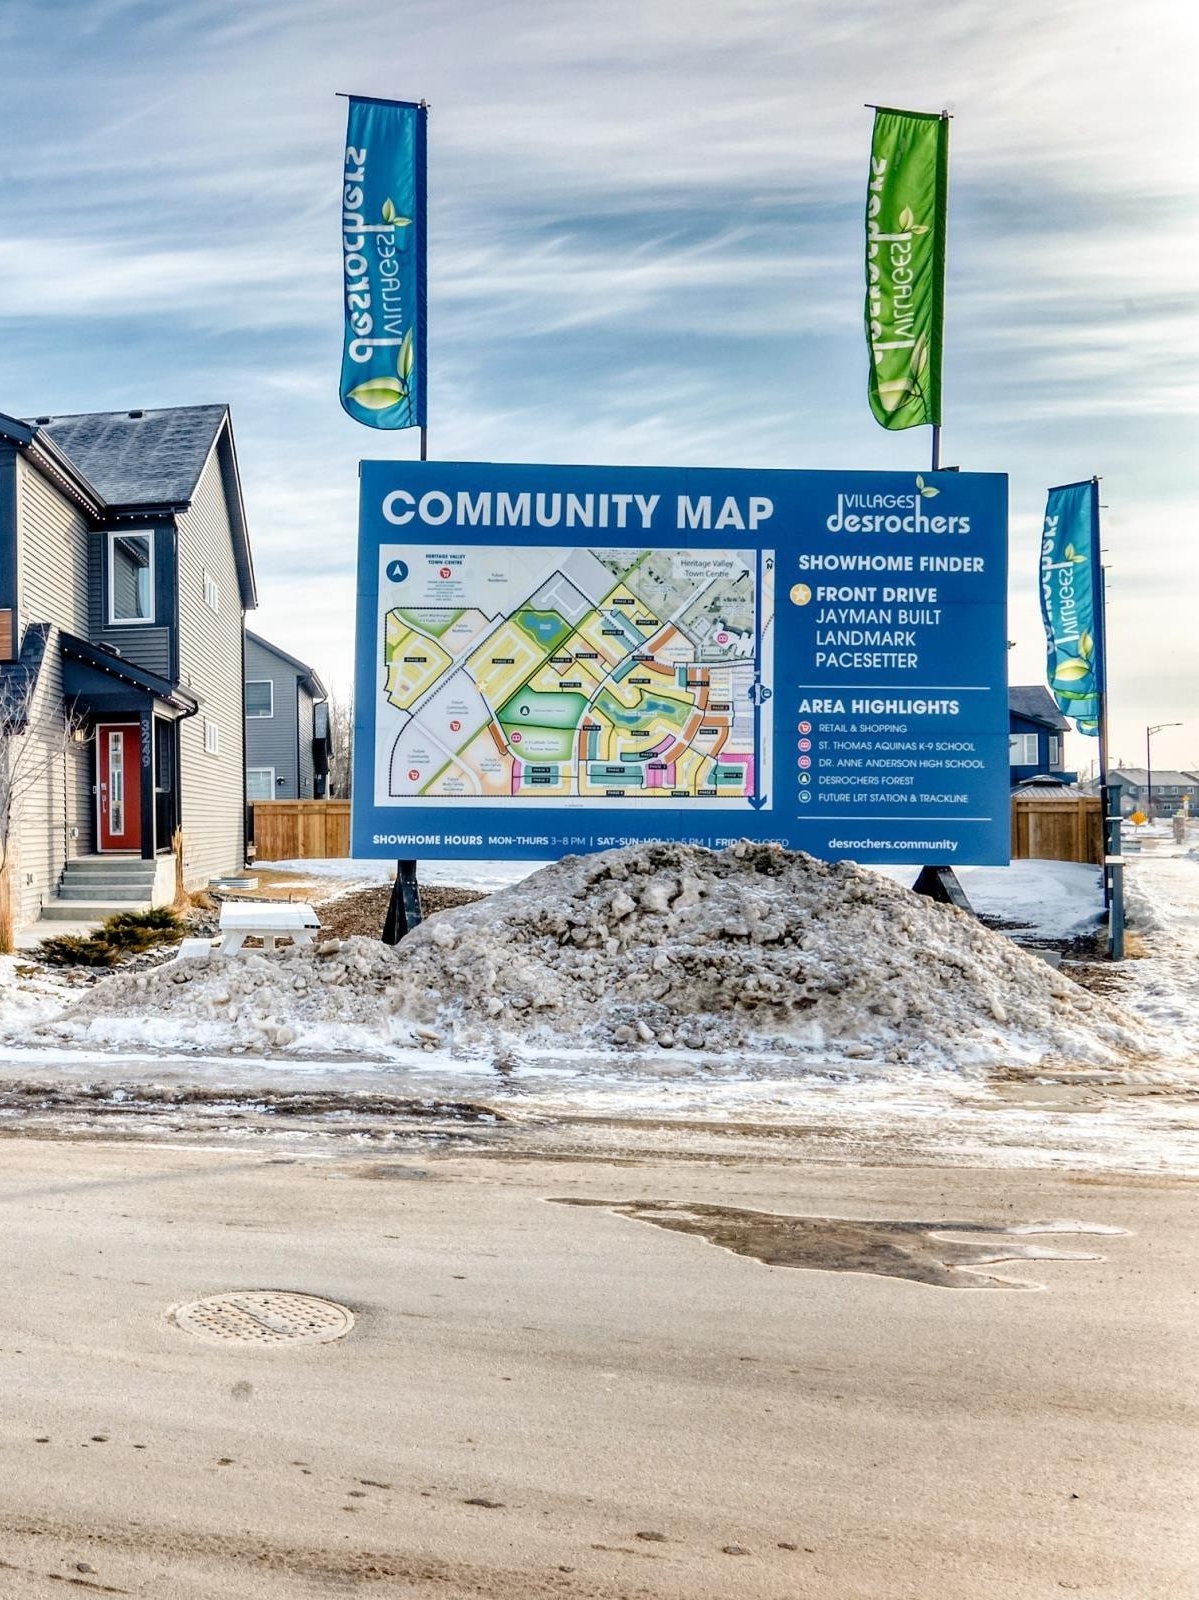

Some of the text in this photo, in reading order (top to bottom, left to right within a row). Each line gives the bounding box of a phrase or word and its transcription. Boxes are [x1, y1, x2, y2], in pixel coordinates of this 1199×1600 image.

[844, 494, 915, 509] VILLAGES
[382, 489, 774, 530] COMMUNITY MAP
[826, 493, 971, 534] desrochers
[681, 559, 734, 569] Heritage Valley
[798, 554, 984, 573] SHOWHOME FINDER
[816, 586, 937, 603] FRONT DRIVE
[815, 608, 941, 625] JAYMAN BUILT
[816, 630, 916, 647] LANDMARK
[815, 652, 918, 669] PACESETTER
[798, 699, 960, 715] AREA HIGHLIGHTS
[818, 723, 908, 733] RETAIL & SHOPPING
[818, 741, 976, 752] ST. THOMAS AQUINAS K-9 SCHOOL
[818, 758, 985, 769] DR. ANNE ANDERSON HIGH SCHOOL
[818, 775, 914, 785] DESROCHERS FOREST
[818, 793, 969, 803] FUTURE LRT STATION & TRACKLINE
[372, 834, 441, 845] SHOWHOME
[444, 835, 483, 845] HOURS
[488, 836, 549, 846] MON-THURS
[570, 836, 586, 846] PM
[828, 838, 958, 851] desrochers.community
